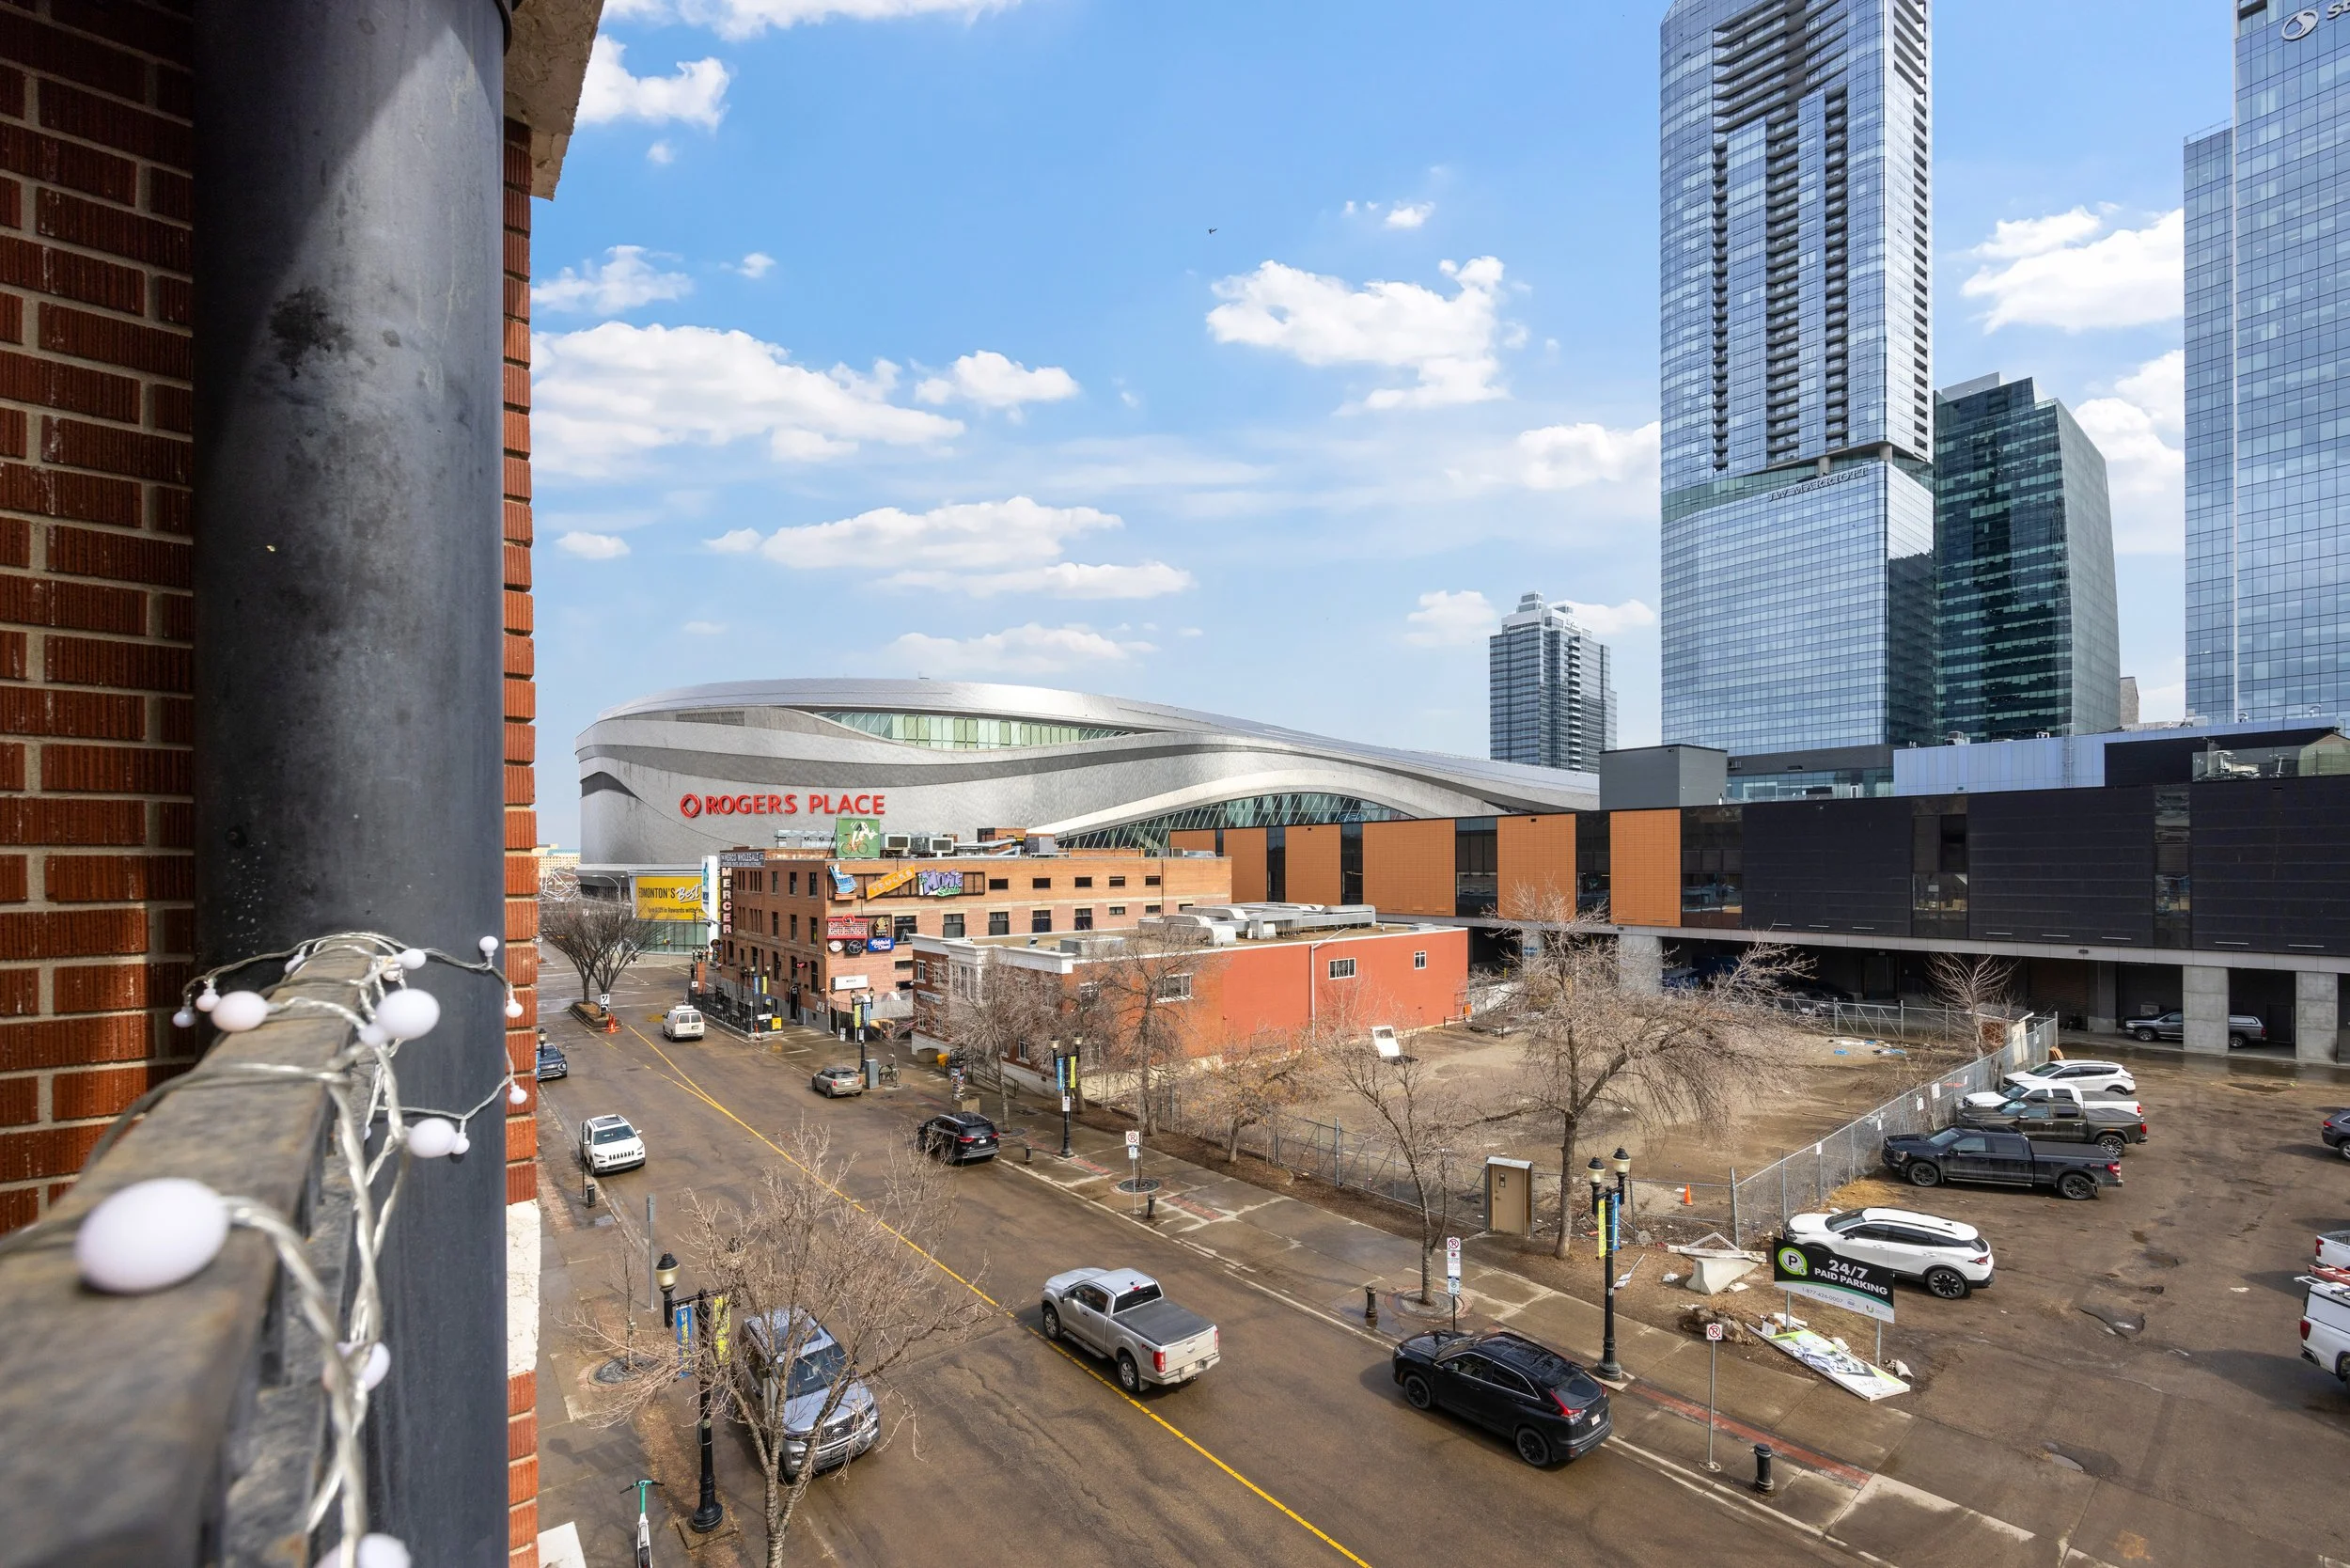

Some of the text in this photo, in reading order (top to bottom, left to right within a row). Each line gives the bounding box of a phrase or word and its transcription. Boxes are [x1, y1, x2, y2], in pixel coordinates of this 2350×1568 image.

[1793, 467, 1868, 494] MARRIOTT
[706, 794, 885, 815] ROGERS PLACE
[638, 886, 676, 900] EDMONTON'S
[676, 883, 702, 902] Best
[721, 867, 732, 934] MERCER
[1814, 1267, 1838, 1280] PAID
[1840, 1277, 1888, 1295] PARKING
[1828, 1259, 1869, 1279] 24/7
